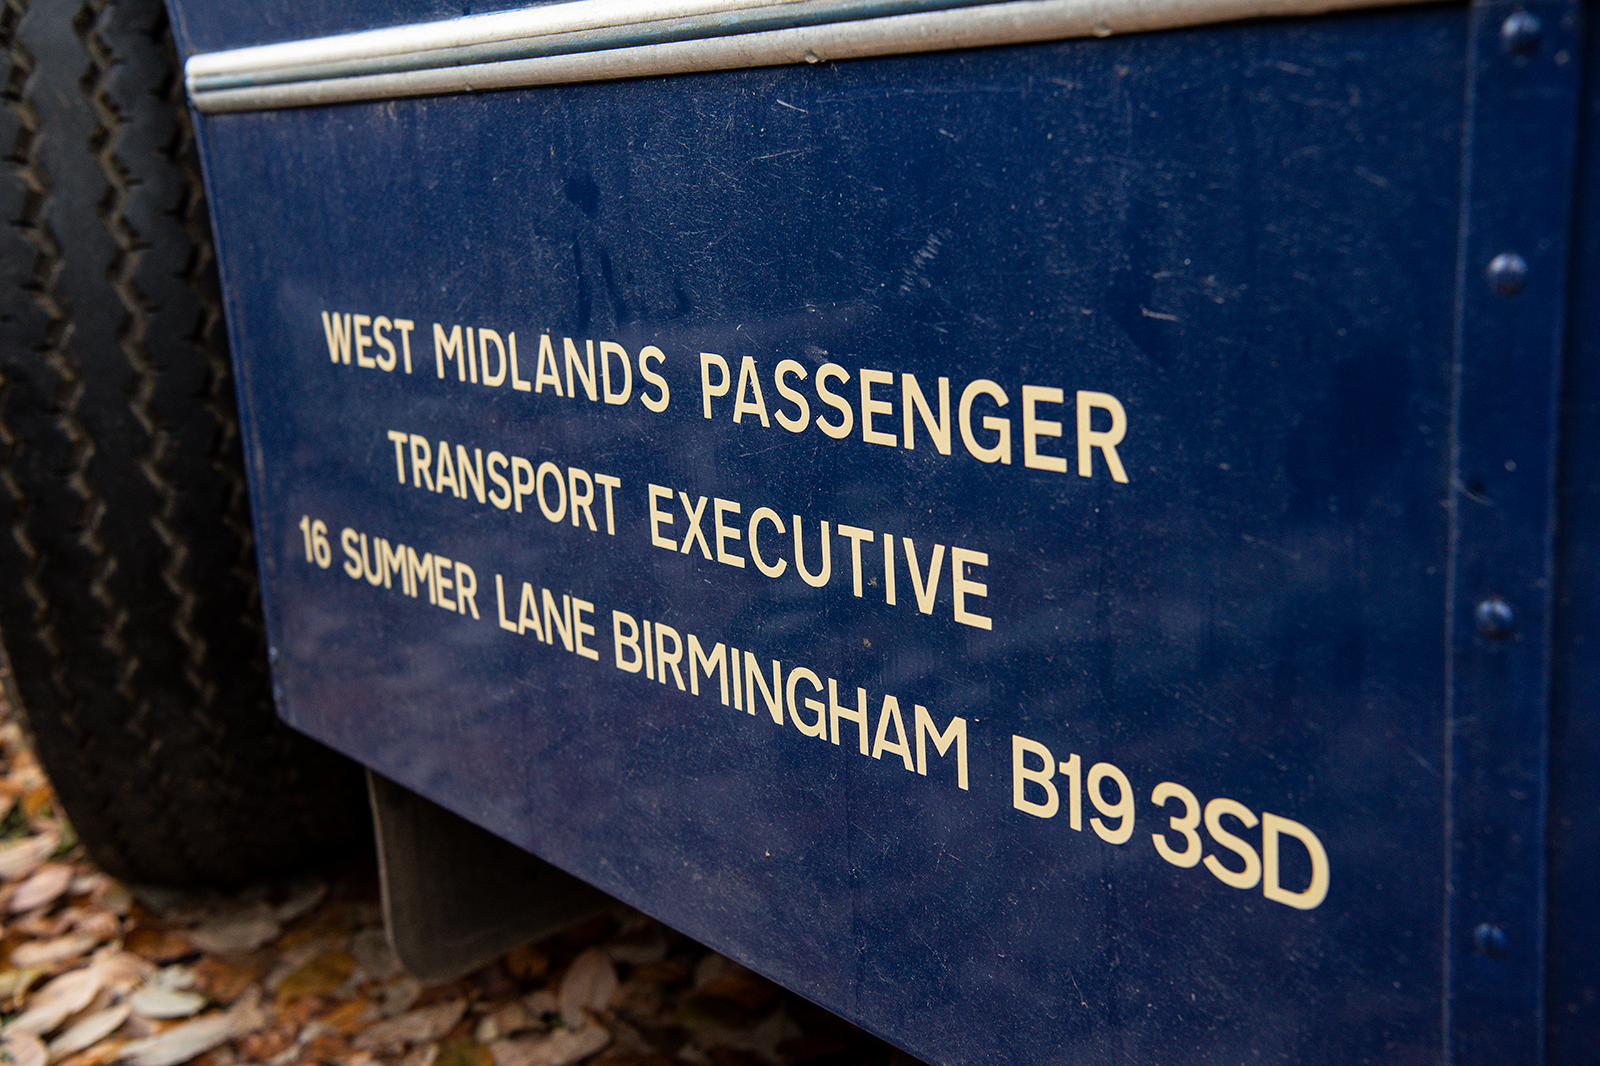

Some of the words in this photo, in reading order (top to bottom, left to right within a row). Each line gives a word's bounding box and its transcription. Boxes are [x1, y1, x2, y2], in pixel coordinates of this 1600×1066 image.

[321, 311, 415, 375] WEST
[433, 323, 670, 413] MIDLANDS
[699, 353, 1129, 484] PASSENGER
[387, 430, 622, 536] TRANSPORT
[648, 484, 993, 631] EXECUTIVE
[299, 515, 332, 569] 16
[341, 527, 481, 620] SUMMER
[495, 573, 600, 662] LANE
[612, 609, 969, 791] BIRMINGHAM
[1012, 734, 1135, 845] B19
[1151, 781, 1330, 910] 3SD
